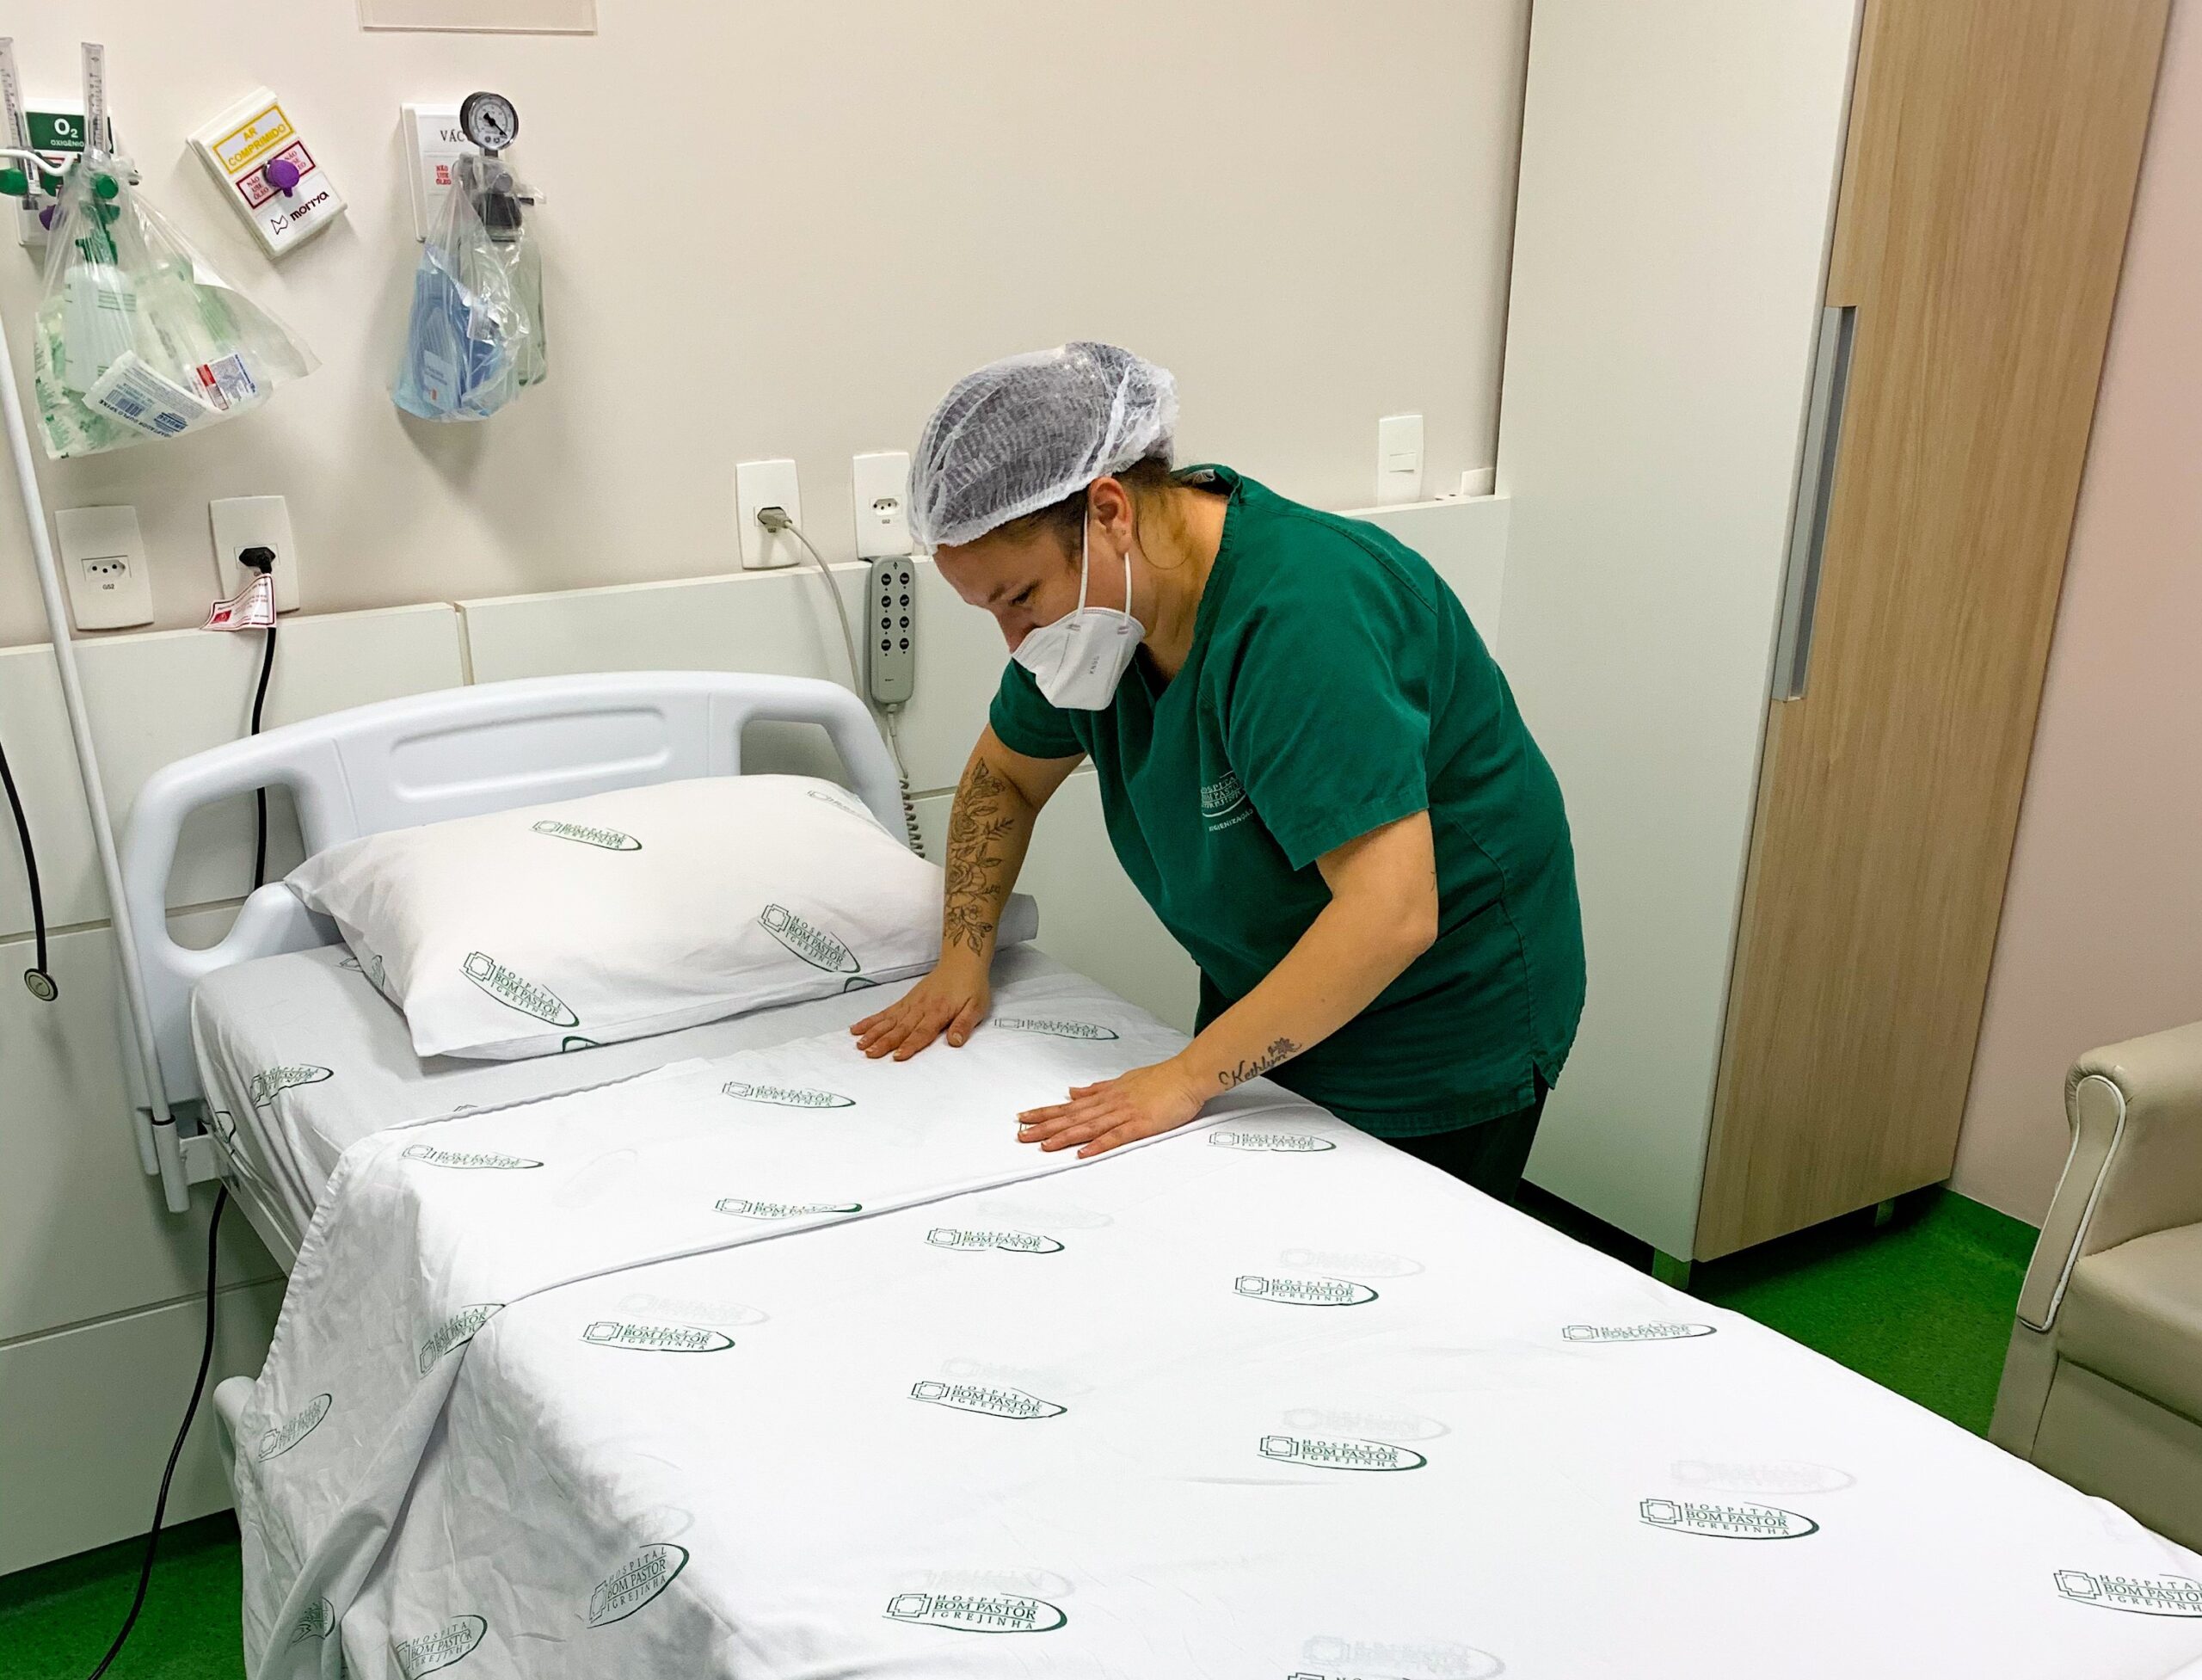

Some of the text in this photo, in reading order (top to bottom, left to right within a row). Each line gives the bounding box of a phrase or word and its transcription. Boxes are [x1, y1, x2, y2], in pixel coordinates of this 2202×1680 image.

[243, 126, 258, 142] AR
[440, 128, 467, 142] VÁC
[228, 124, 286, 166] COMPRIMIDO
[247, 176, 260, 187] NÃO
[252, 183, 262, 193] USE
[290, 191, 329, 221] morrya
[789, 923, 844, 964] BOM PASTOR
[793, 915, 847, 957] HOSPITAL
[784, 932, 840, 971] IGREJINHA
[494, 972, 559, 1017] BOM PASTOR
[499, 965, 563, 1011] HOSPITAL
[490, 982, 555, 1023] IGREJINHA
[1272, 1278, 1354, 1289] HOSPITAL
[1306, 1286, 1354, 1296] PASTOR
[1271, 1291, 1353, 1303] IGREJINHA
[624, 1329, 710, 1344] BOM PASTOR
[626, 1324, 712, 1338] HOSPITAL
[620, 1337, 704, 1350] IGREJINHA
[952, 1389, 1041, 1413] BOM PASTOR
[954, 1384, 1043, 1406] HOSPITAL
[950, 1396, 1038, 1417] IGREJINHA
[1302, 1439, 1399, 1454] HOSPITAL
[1302, 1446, 1398, 1462] BOM PASTOR
[1301, 1454, 1397, 1468] IGREJINHA
[1684, 1503, 1787, 1518] HOSPITAL
[1687, 1511, 1787, 1527] BOM PASTOR
[1687, 1520, 1790, 1535] IGREJINHA
[609, 1547, 667, 1582] HOSPITAL
[607, 1559, 666, 1599] BOM PASTOR
[606, 1574, 666, 1612] IGREJINHA
[2104, 1584, 2202, 1602] BOM PASTO
[937, 1595, 1039, 1609] HOSPITAL
[933, 1602, 1037, 1621] BOM PASTOR
[931, 1611, 1033, 1630] IGREJINHA
